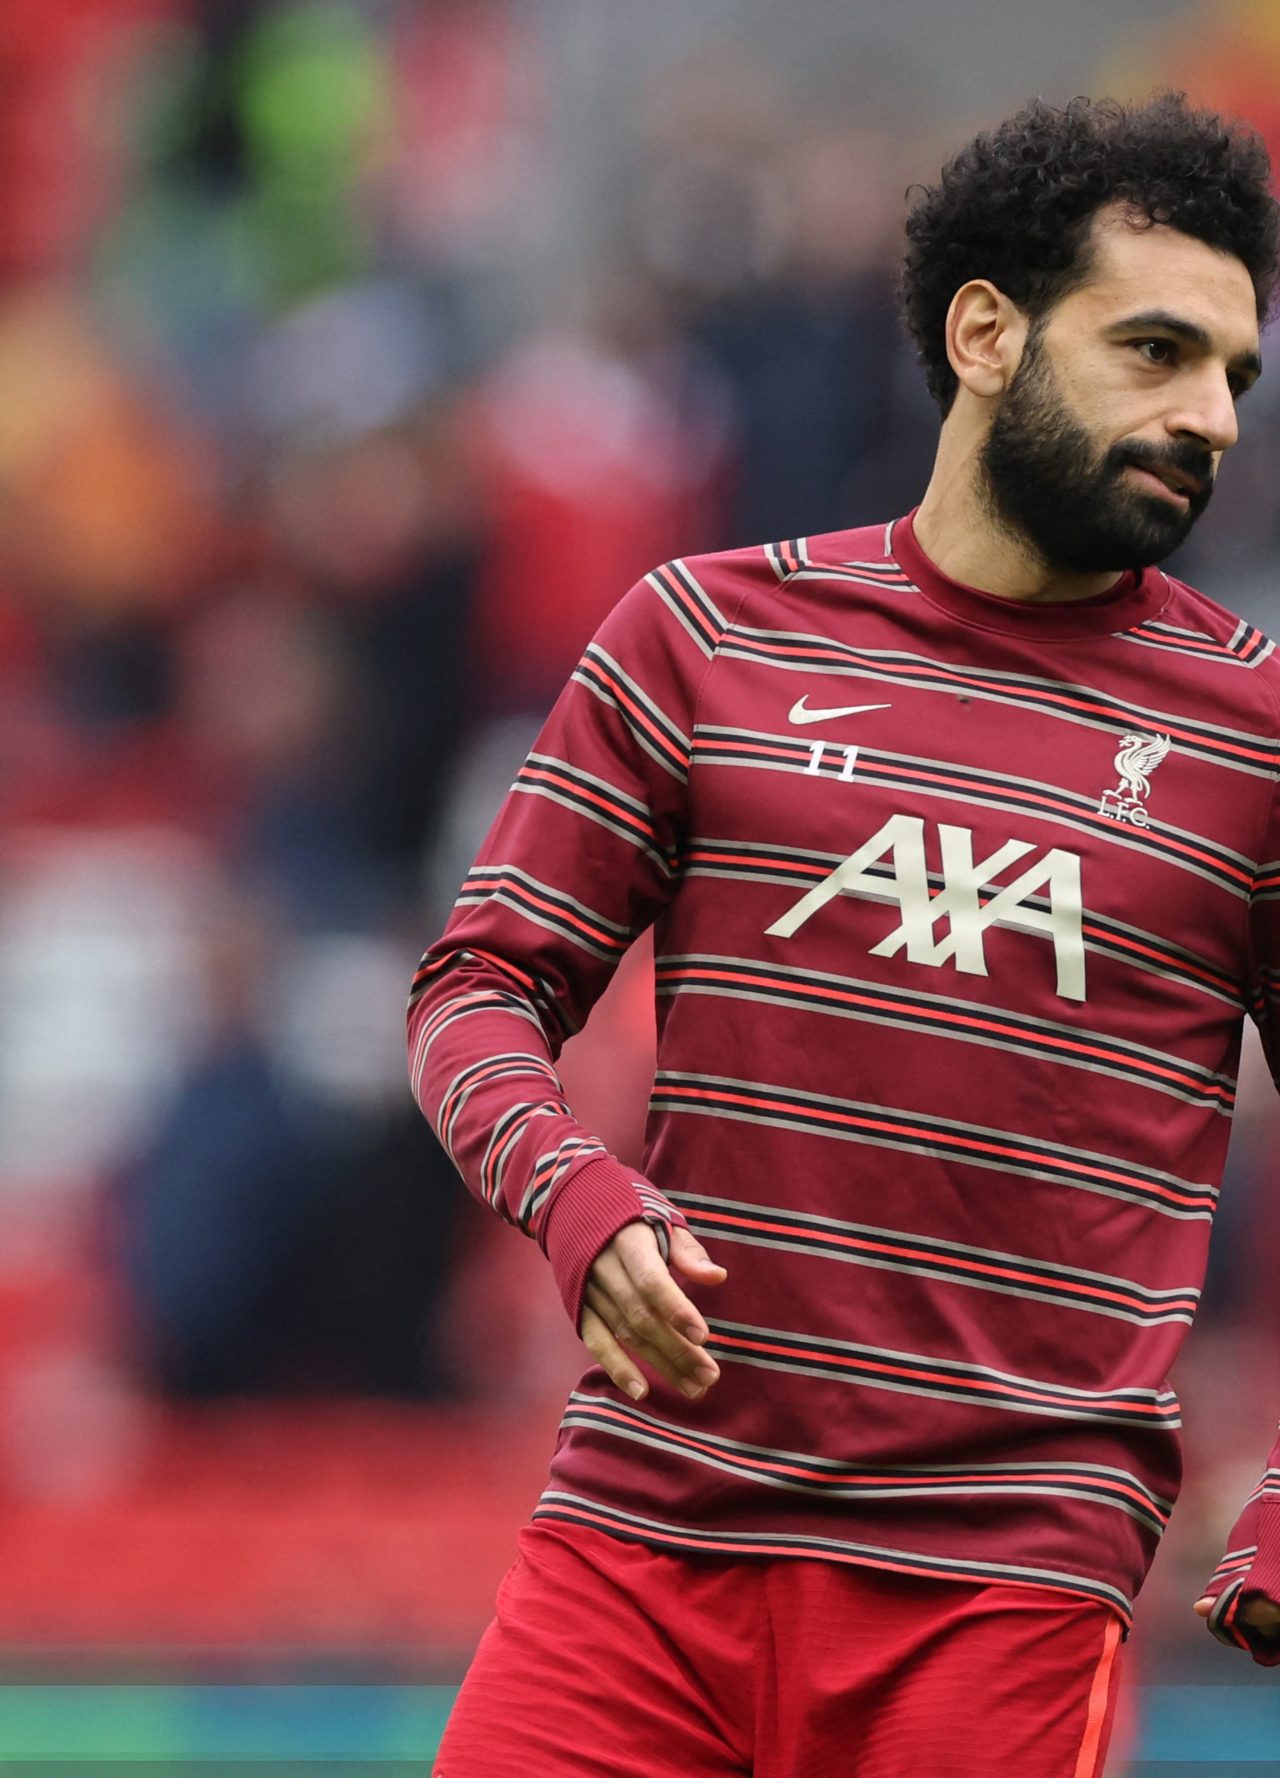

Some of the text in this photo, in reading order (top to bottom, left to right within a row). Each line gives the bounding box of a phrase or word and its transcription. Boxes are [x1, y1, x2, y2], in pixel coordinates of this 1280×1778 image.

[803, 740, 859, 783] 11
[1097, 796, 1150, 829] L.F.C.
[764, 814, 1086, 1001] AXA
